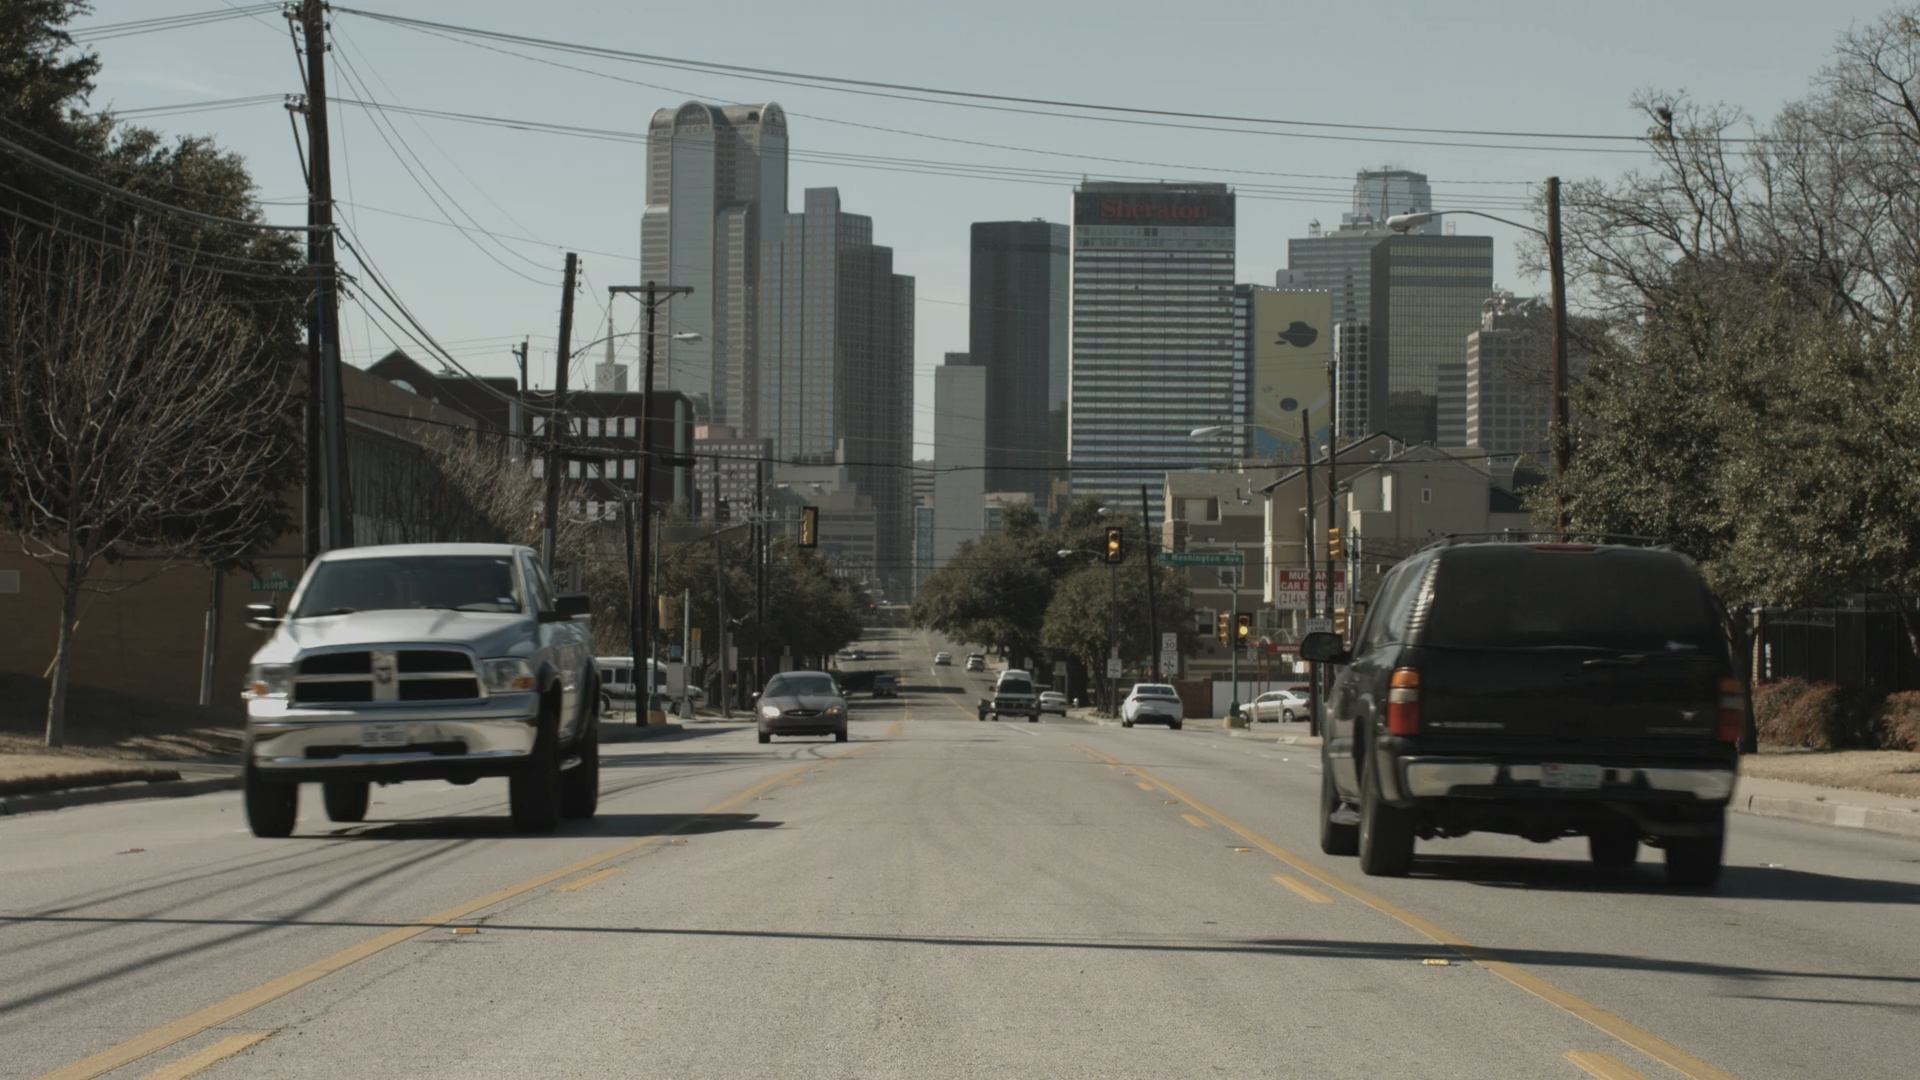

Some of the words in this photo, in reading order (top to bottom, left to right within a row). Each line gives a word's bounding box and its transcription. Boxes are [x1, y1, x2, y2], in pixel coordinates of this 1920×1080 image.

[1101, 200, 1208, 218] Sheraton
[1172, 555, 1220, 563] Washington
[1289, 572, 1336, 580] MUSAN
[1281, 582, 1300, 590] CAR
[1303, 582, 1344, 590] SRVCE
